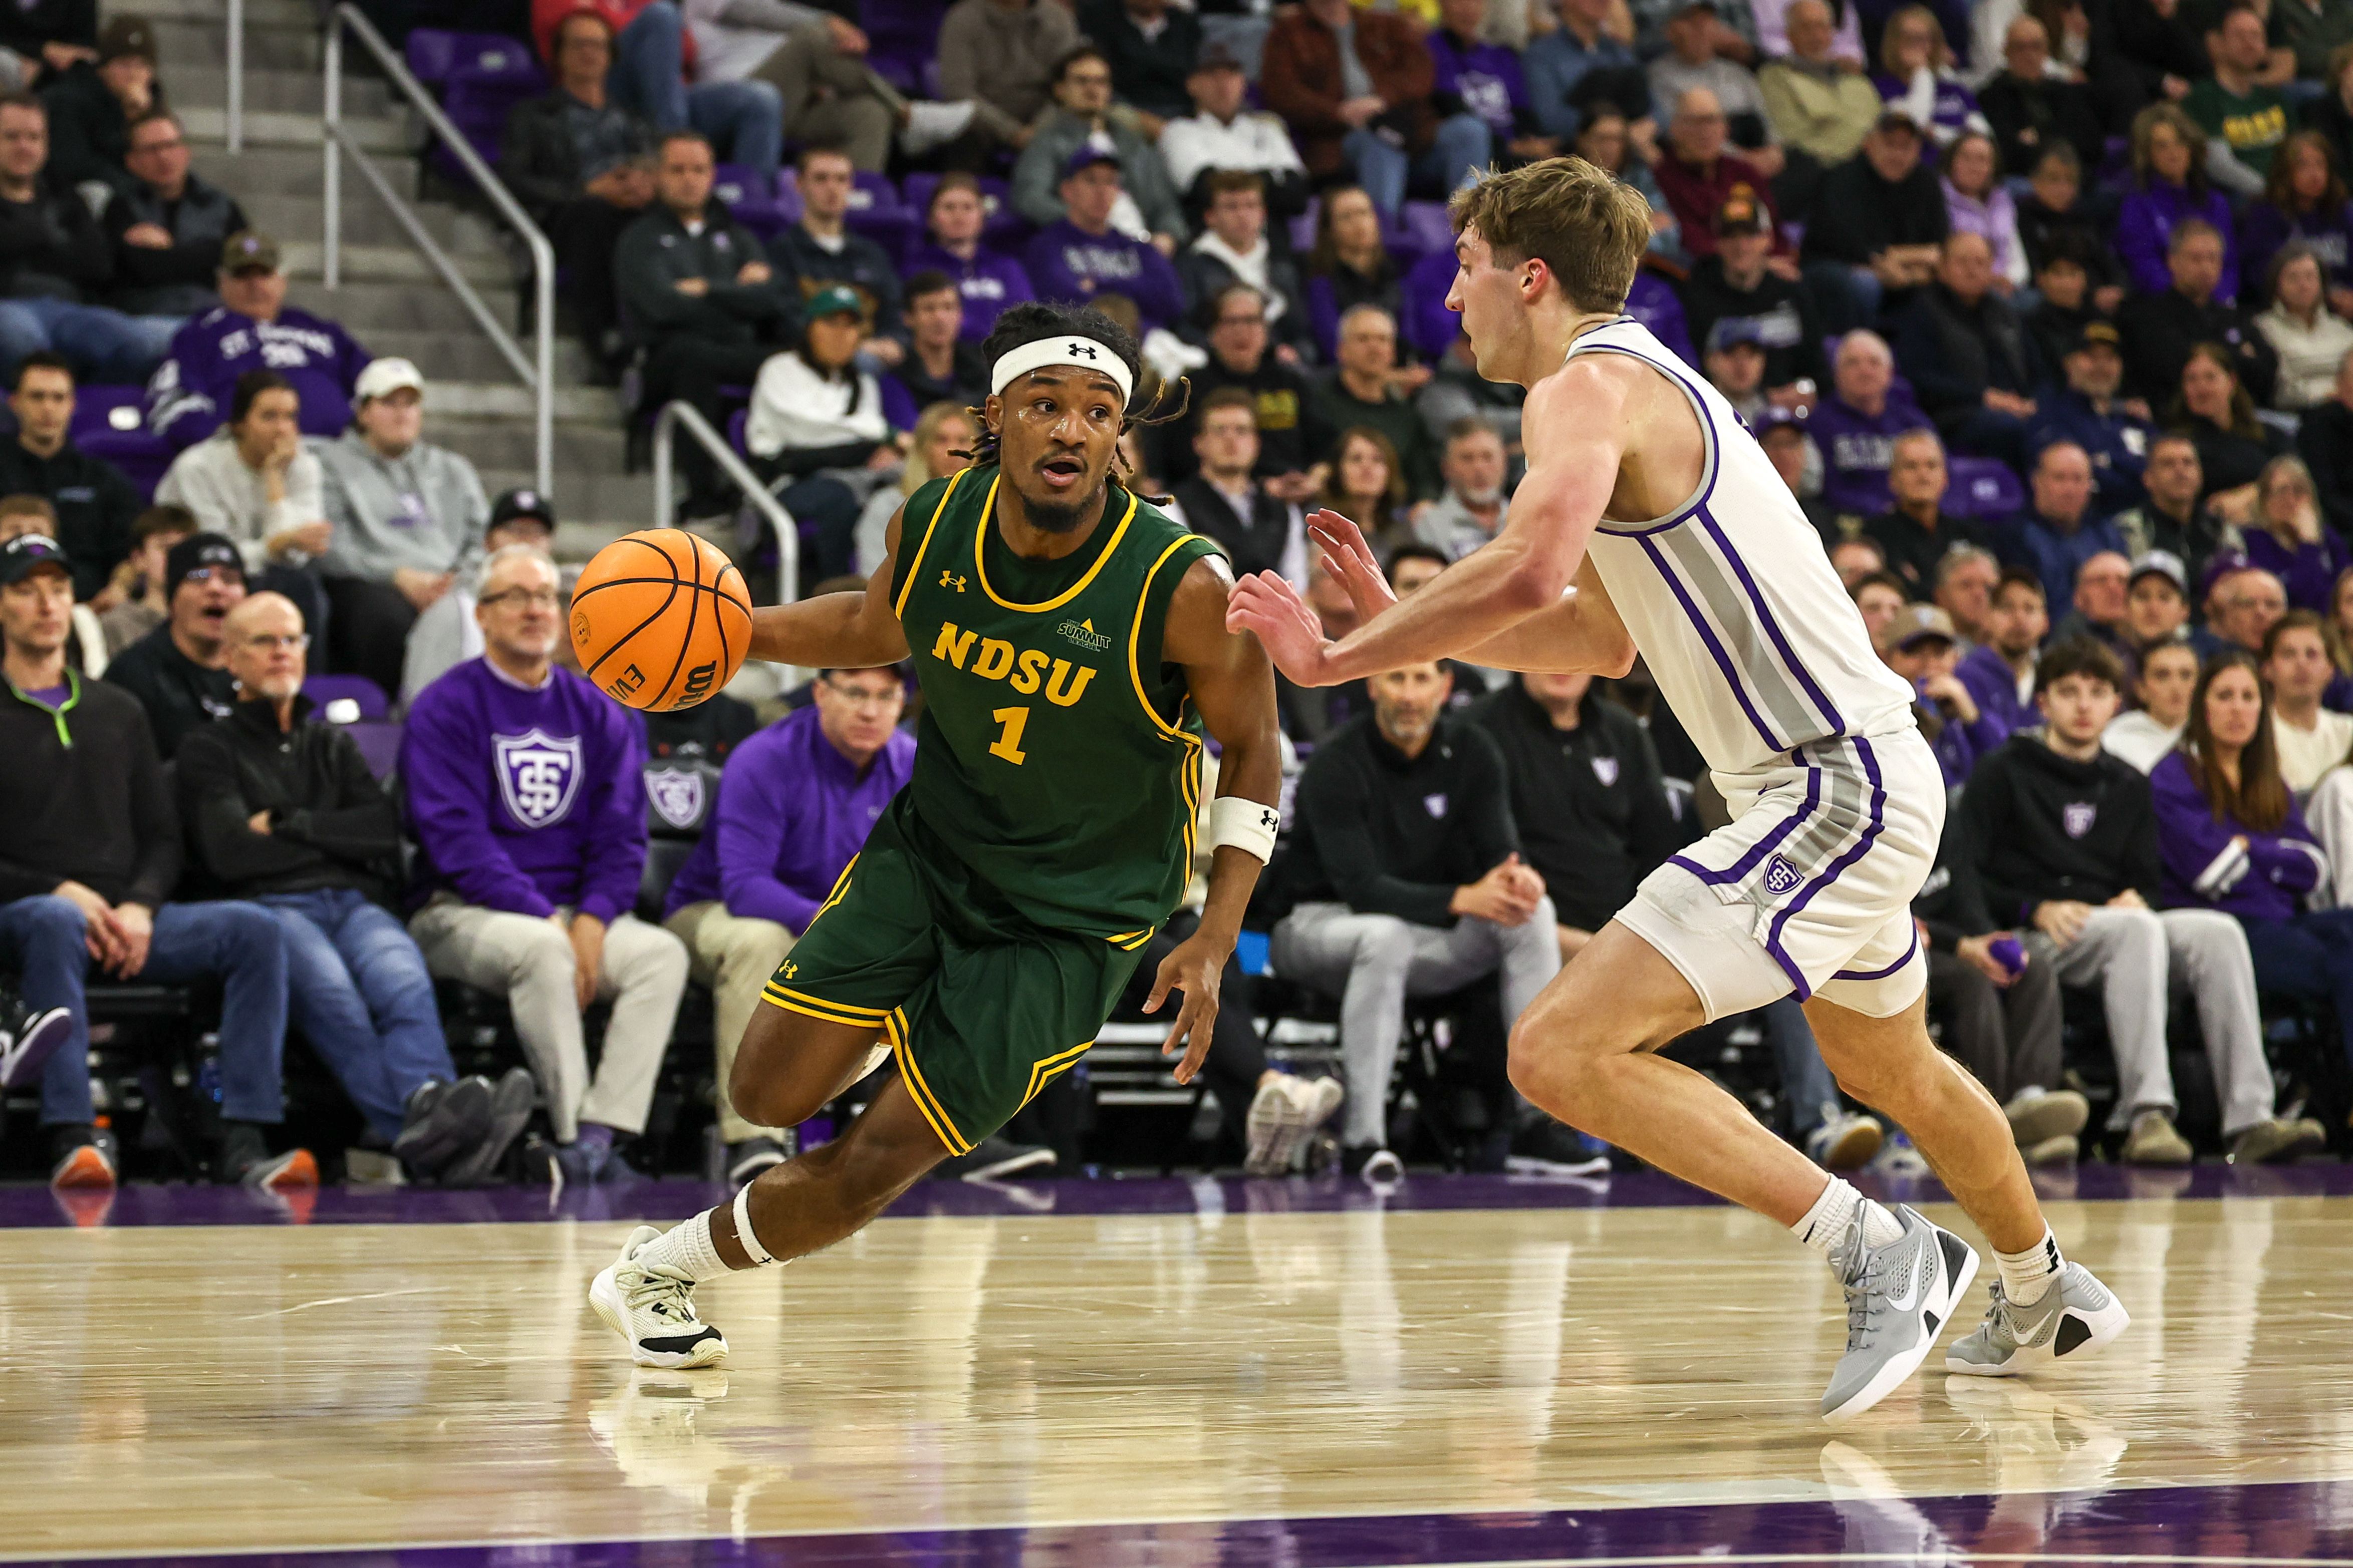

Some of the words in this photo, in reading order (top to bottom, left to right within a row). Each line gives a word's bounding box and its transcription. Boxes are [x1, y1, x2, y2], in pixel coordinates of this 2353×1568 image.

[1057, 622, 1111, 649] SUMMIT
[1068, 637, 1098, 652] LEAGUE
[932, 621, 1098, 707] NDSU
[988, 707, 1030, 766] 1
